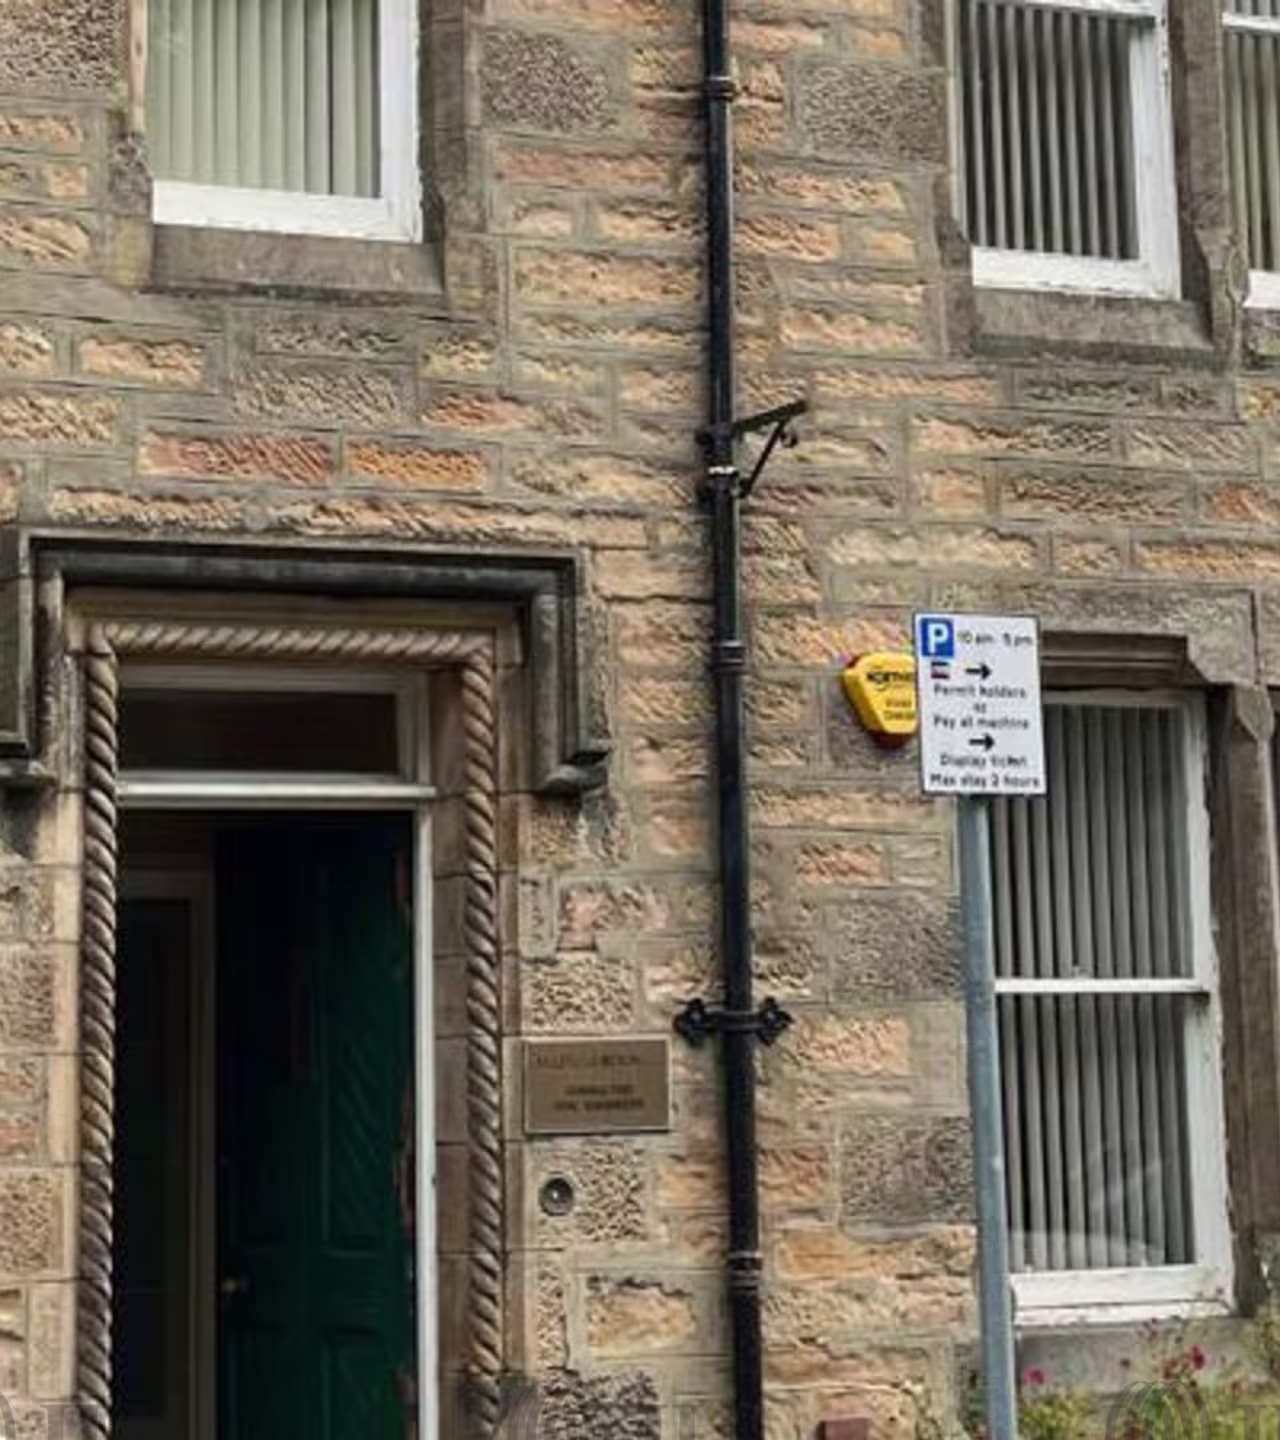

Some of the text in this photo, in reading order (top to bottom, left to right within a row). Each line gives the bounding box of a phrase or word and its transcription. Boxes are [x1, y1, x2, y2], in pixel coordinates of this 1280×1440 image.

[928, 622, 950, 654] P
[933, 683, 1027, 699] Permit holders
[933, 714, 1030, 730] Pay at machine
[940, 753, 1026, 769] Display ticket
[930, 773, 1039, 789] Max stay 2 hours
